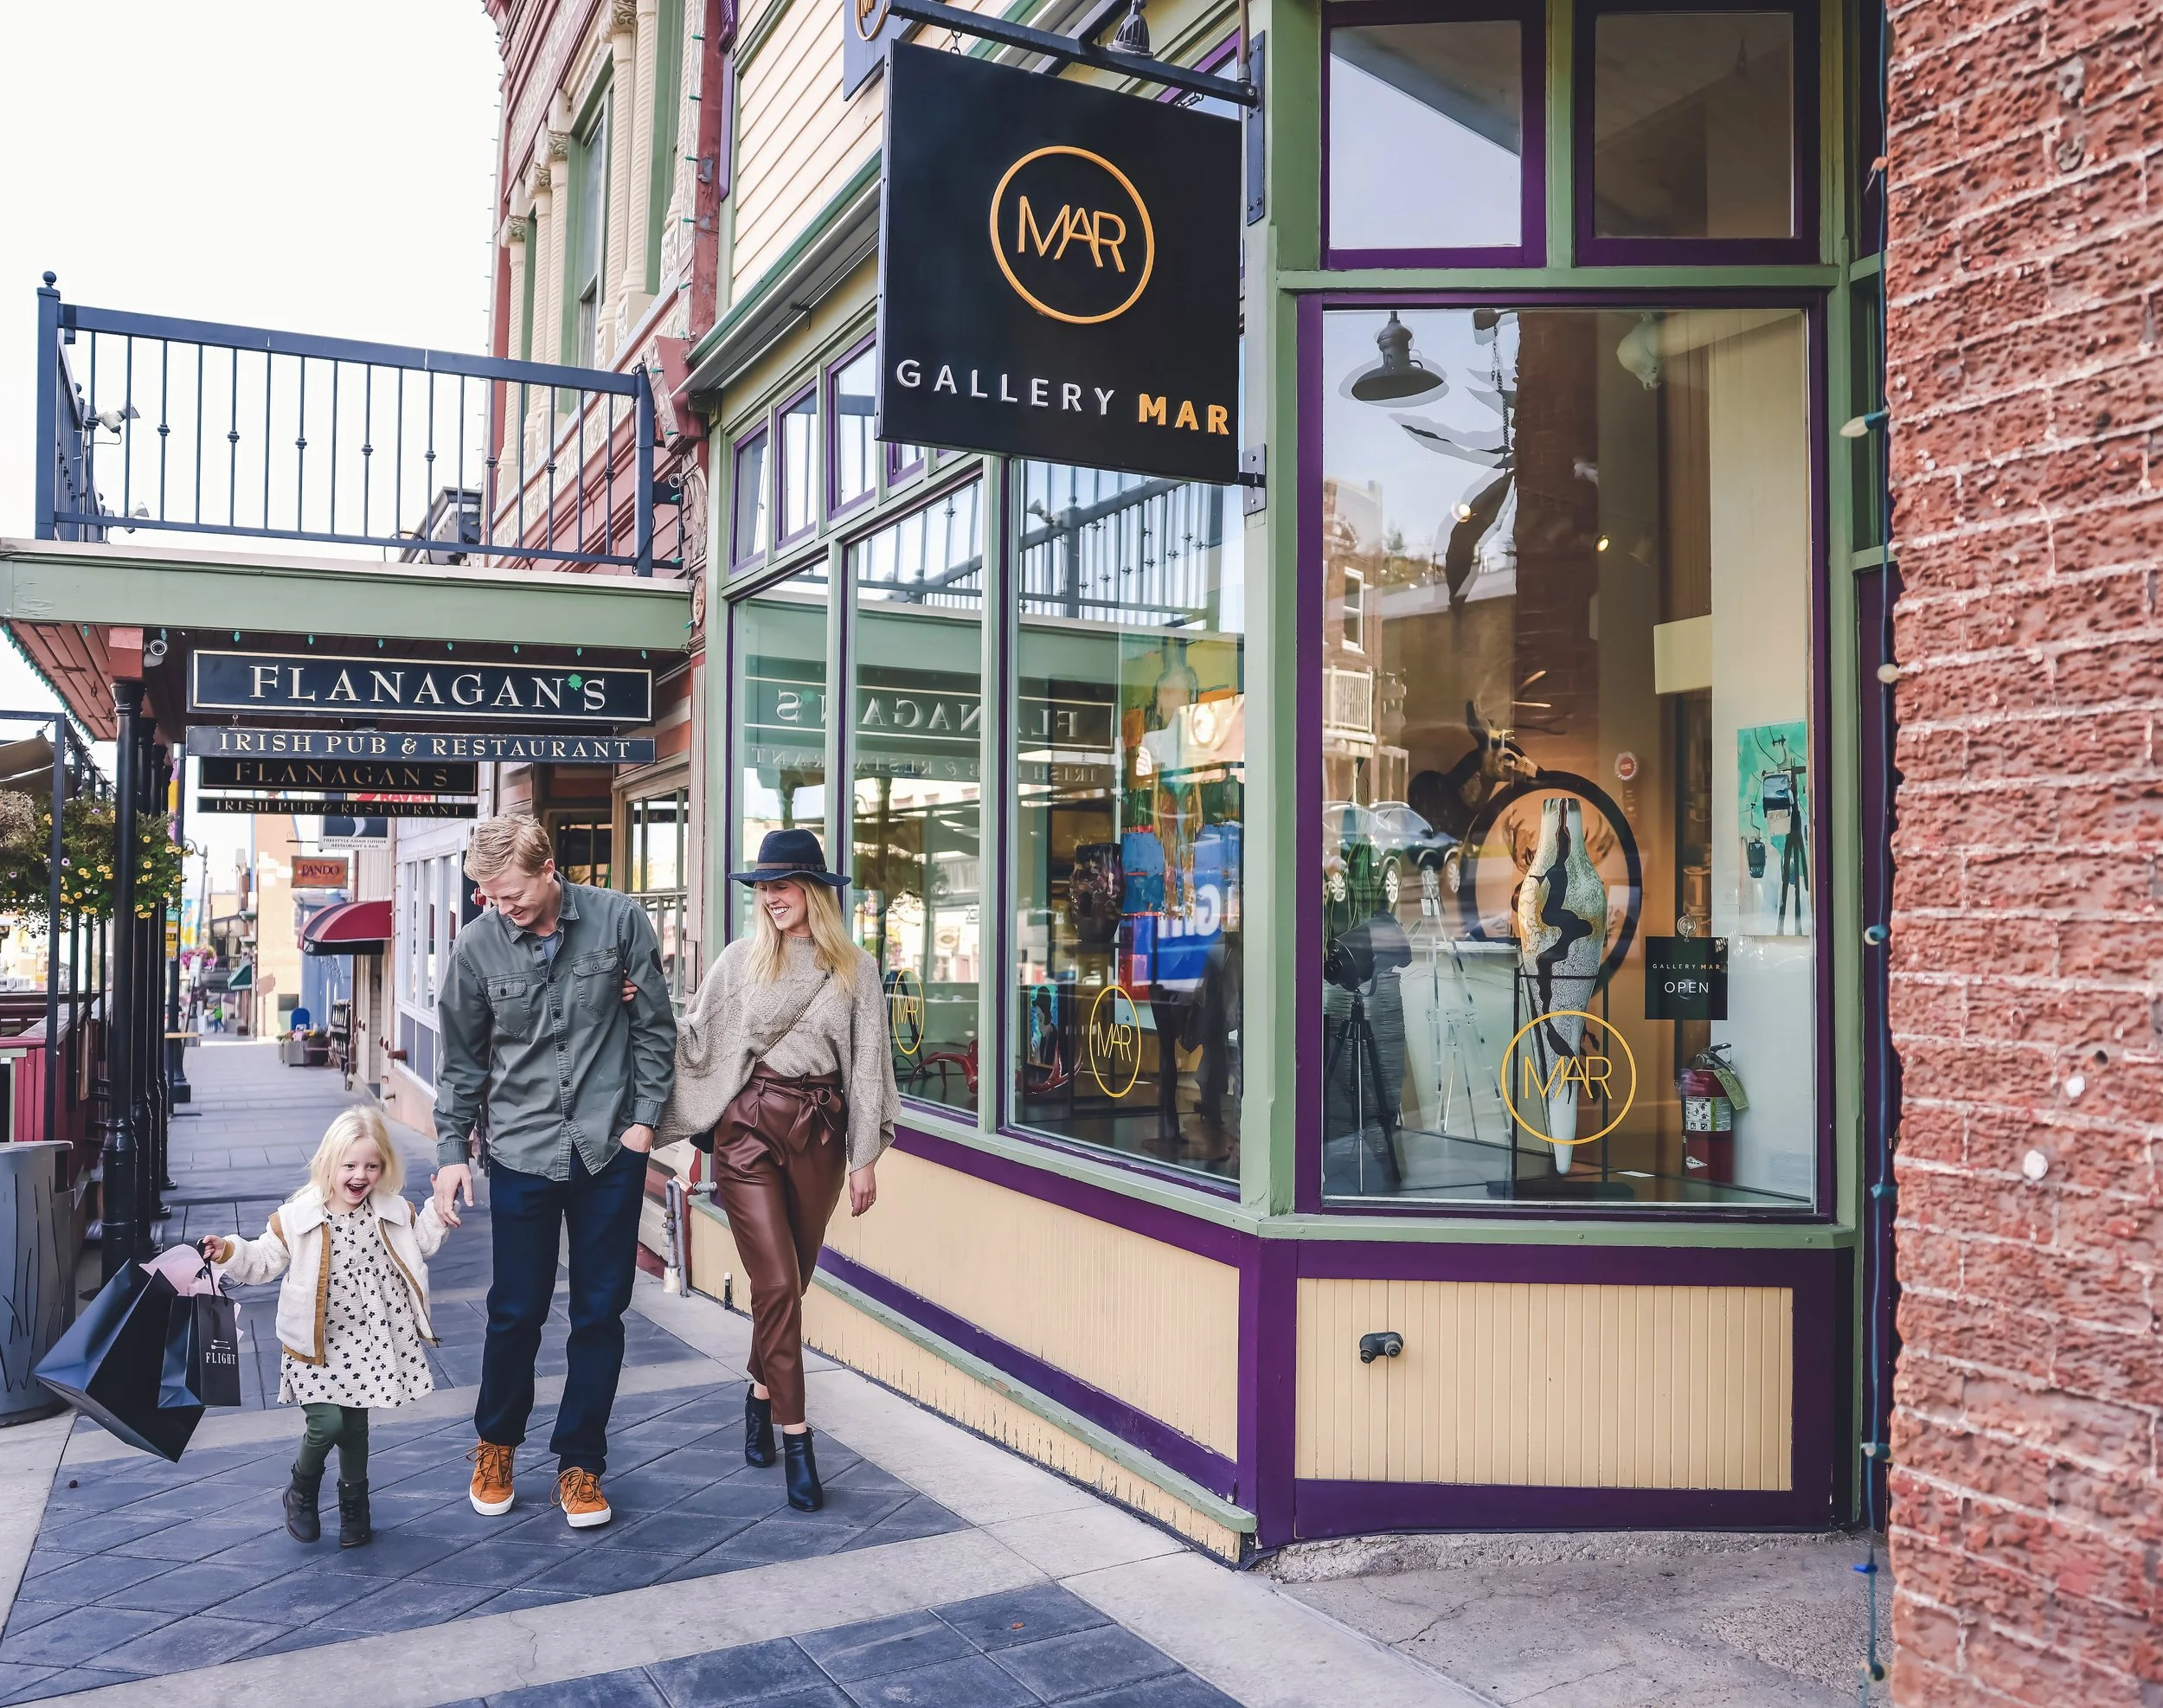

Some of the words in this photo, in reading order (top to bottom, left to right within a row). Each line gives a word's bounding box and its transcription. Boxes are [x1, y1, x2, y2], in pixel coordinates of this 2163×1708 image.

[1017, 196, 1126, 273] MAR
[896, 359, 1114, 415] GALLERY
[1138, 393, 1229, 435] MAR
[248, 665, 607, 711] FLANAGAN'S
[219, 733, 312, 753] IRISH
[325, 735, 387, 754] PUB
[401, 738, 417, 754] &
[431, 738, 631, 758] RESTAURANT
[215, 799, 268, 812] IRISH
[278, 801, 314, 812] PUB
[321, 803, 332, 812] &
[341, 802, 461, 816] RESTAURANT
[1664, 981, 1709, 993] OPEN
[897, 996, 919, 1025] MAR
[1097, 1021, 1132, 1063] MAR
[1524, 1056, 1613, 1100] MAR
[205, 1352, 236, 1364] FLIGHT
